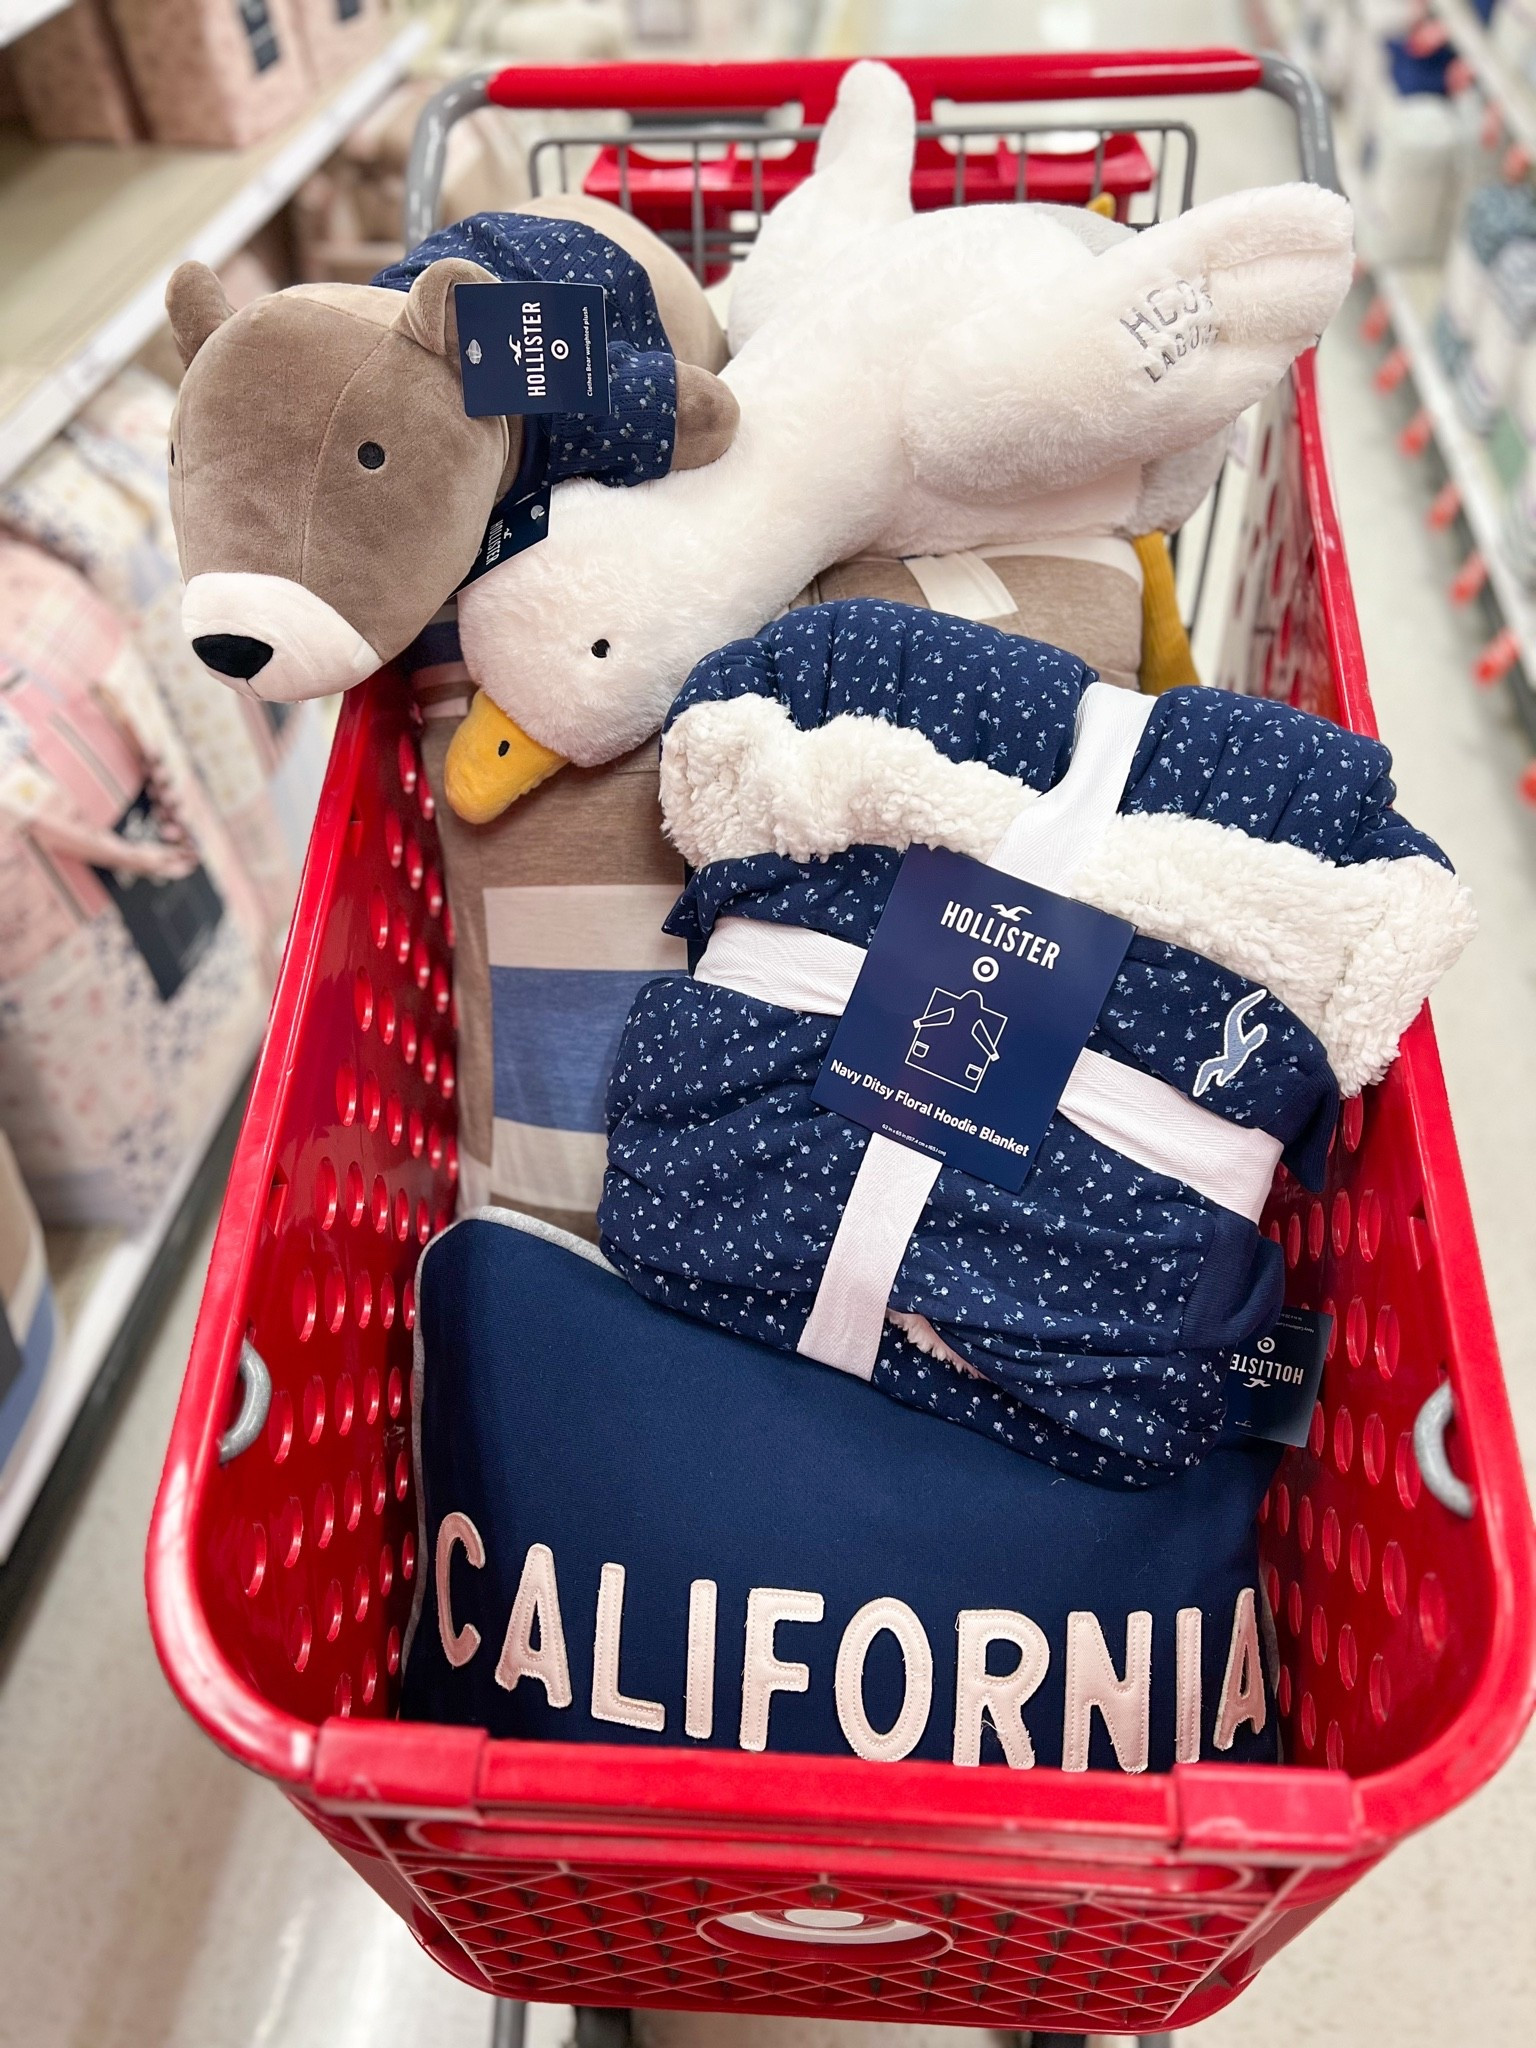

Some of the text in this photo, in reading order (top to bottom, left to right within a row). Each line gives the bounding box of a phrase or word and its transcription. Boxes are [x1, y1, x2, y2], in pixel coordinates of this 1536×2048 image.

[522, 302, 546, 397] HOLLISTER
[583, 326, 591, 355] weighted
[486, 519, 503, 565] HOLLISTER
[940, 900, 1061, 970] HOLLISTER
[830, 1059, 1030, 1157] Navy Ditsy Floral Hoodie Blanket
[1229, 1353, 1304, 1385] HOLLISTE
[435, 1511, 1267, 1774] CALIFORNIA
